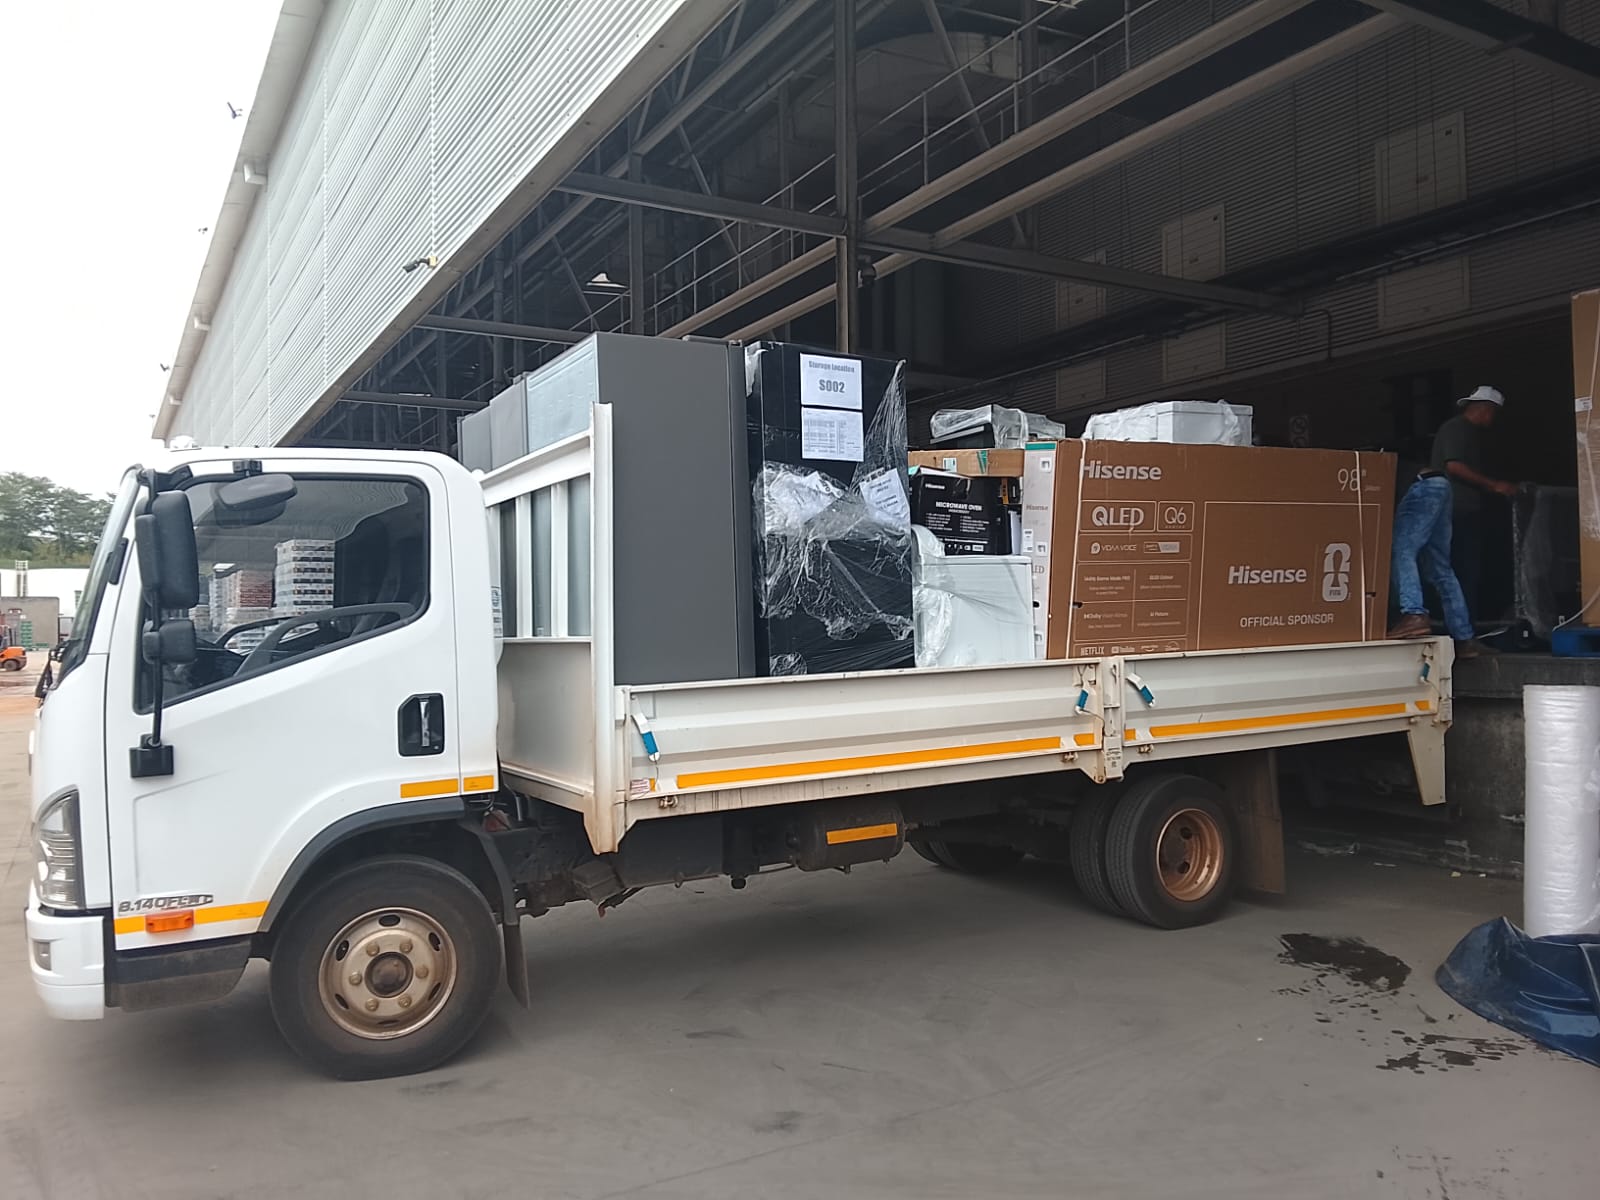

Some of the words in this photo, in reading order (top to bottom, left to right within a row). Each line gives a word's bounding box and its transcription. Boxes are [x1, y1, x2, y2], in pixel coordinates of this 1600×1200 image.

[808, 360, 831, 371] Storage
[832, 363, 855, 373] Location
[819, 379, 846, 394] S002
[1080, 460, 1162, 480] Hisense
[935, 501, 968, 510] MICROWAVE
[968, 504, 983, 512] OVEN
[1091, 506, 1145, 527] QLED
[1164, 506, 1187, 525] Q6
[1228, 565, 1307, 584] Hisense
[1240, 616, 1285, 628] OFFICIAL
[1287, 613, 1334, 626] SPONSOR
[1081, 646, 1105, 656] NETFLIX
